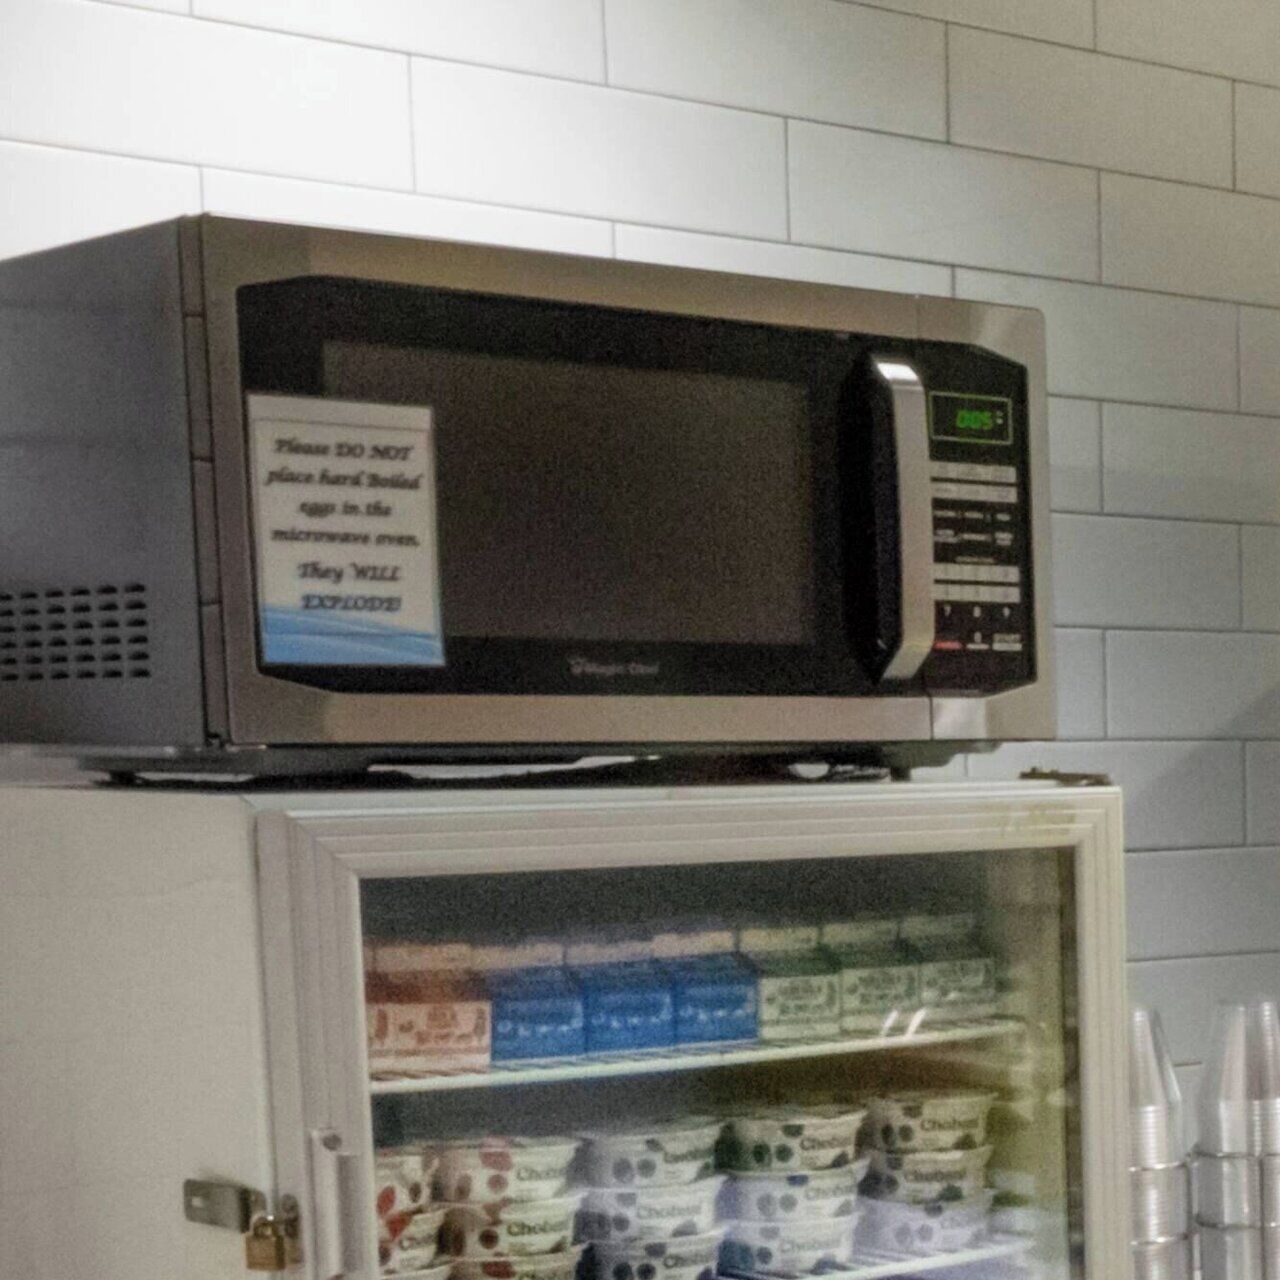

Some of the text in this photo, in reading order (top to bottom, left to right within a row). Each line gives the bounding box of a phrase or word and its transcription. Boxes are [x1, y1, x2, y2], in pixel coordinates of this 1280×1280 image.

[274, 437, 414, 461] Please DO NOT
[266, 466, 314, 486] place
[319, 468, 365, 486] hard
[299, 501, 392, 519] eggs in the
[271, 526, 370, 544] microwave
[297, 561, 400, 585] They WILL
[301, 593, 402, 613] EXPLODE
